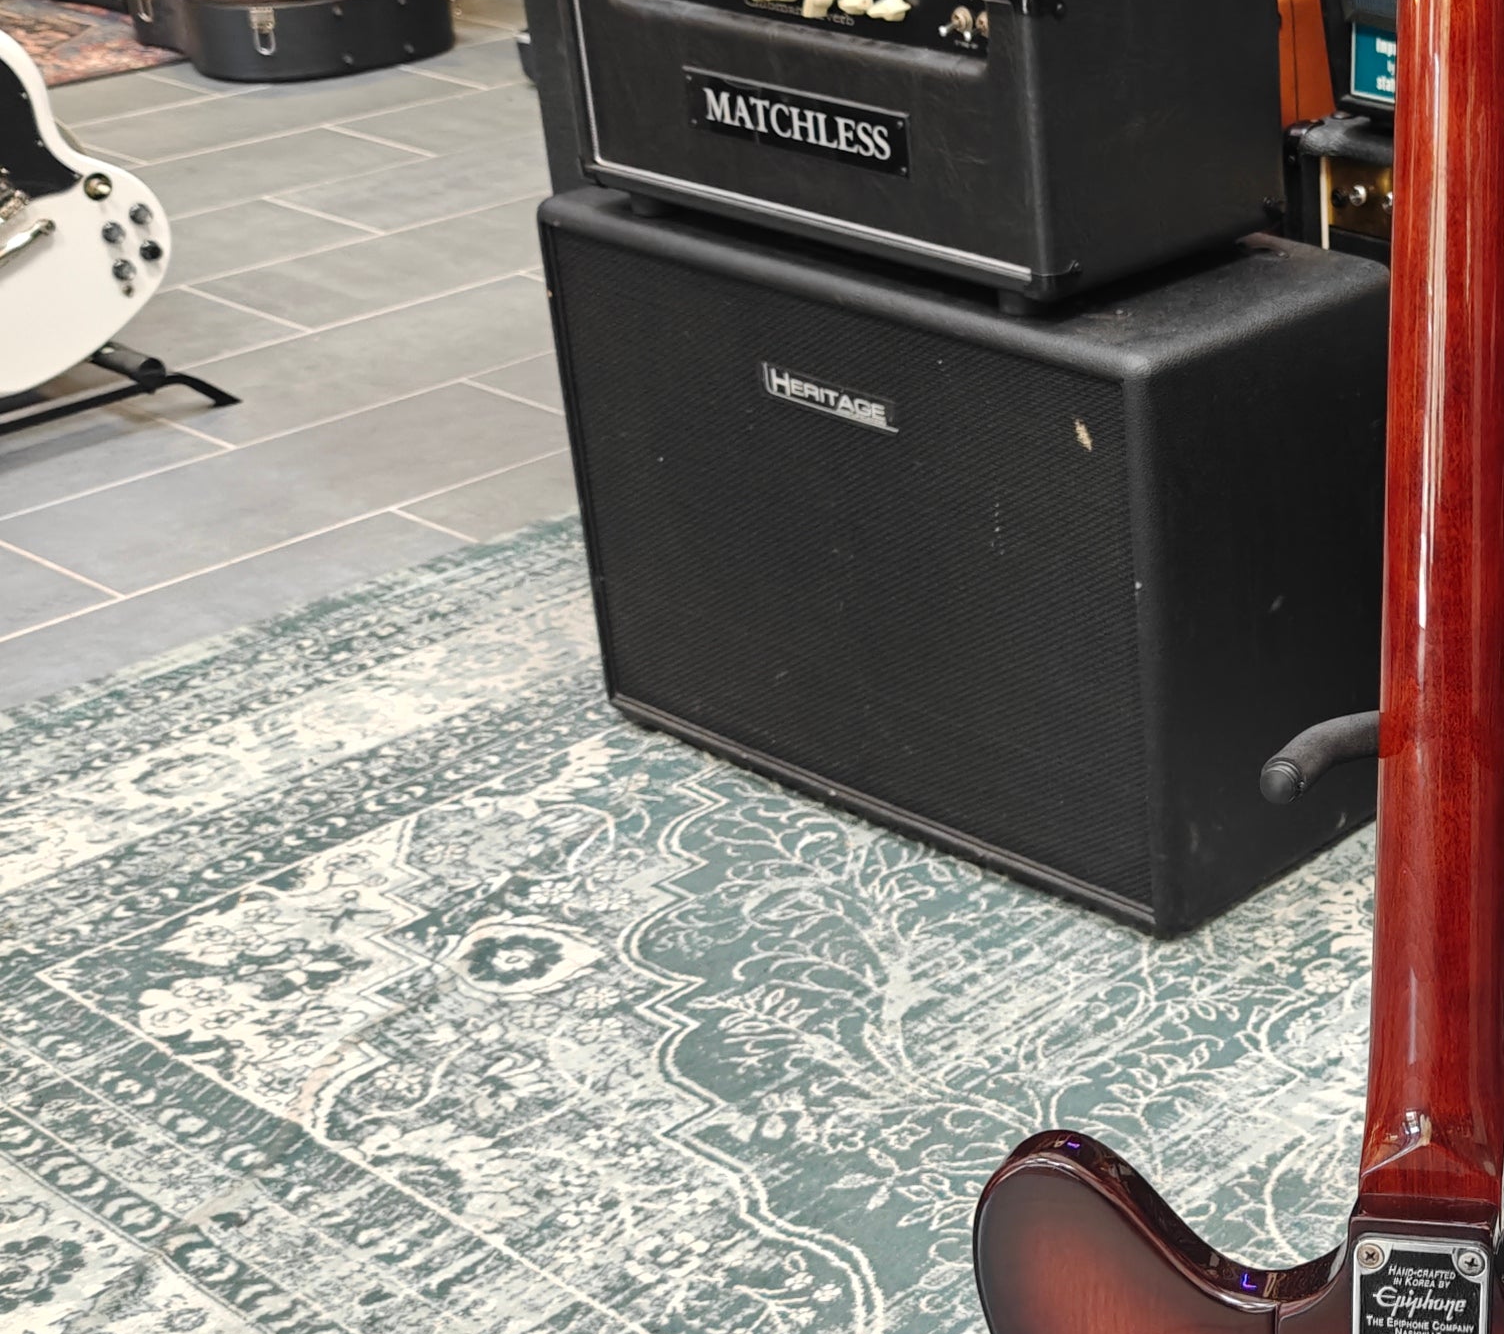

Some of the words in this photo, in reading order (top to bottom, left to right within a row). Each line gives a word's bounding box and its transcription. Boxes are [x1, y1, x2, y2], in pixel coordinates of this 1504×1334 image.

[702, 87, 892, 161] MATCHLESS
[769, 367, 886, 418] HERITAGE
[1387, 1264, 1457, 1281] HAND-CRAFTED
[1392, 1277, 1403, 1286] IN
[1404, 1276, 1436, 1288] KOREA
[1438, 1280, 1451, 1289] BY
[1372, 1285, 1468, 1321] Epiphone
[1366, 1314, 1384, 1327] THE
[1386, 1317, 1430, 1331] EPIPHONE
[1432, 1320, 1475, 1334] COMPANY
